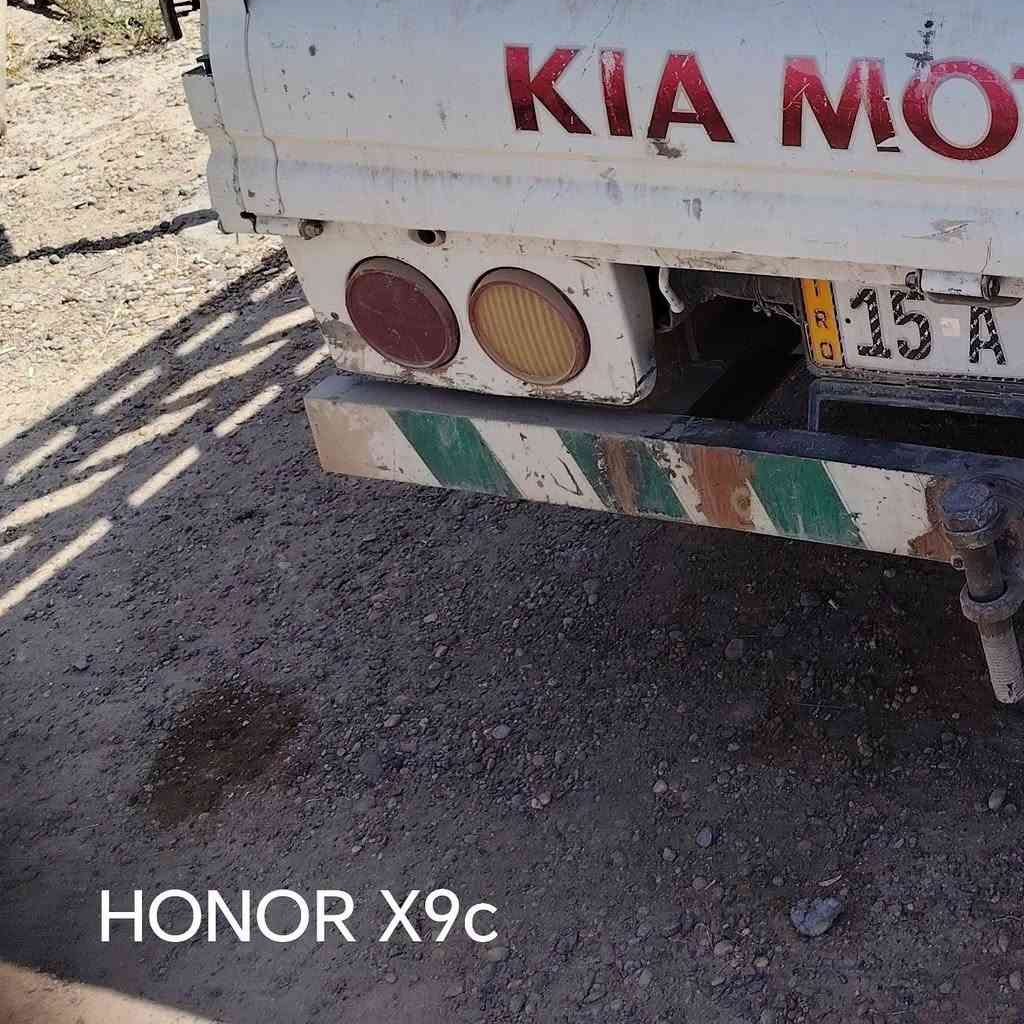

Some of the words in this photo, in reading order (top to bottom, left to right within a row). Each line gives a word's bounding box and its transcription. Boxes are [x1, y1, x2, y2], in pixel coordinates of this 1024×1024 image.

[504, 42, 736, 144] KIA
[849, 288, 932, 361] 15
[968, 306, 1006, 365] A
